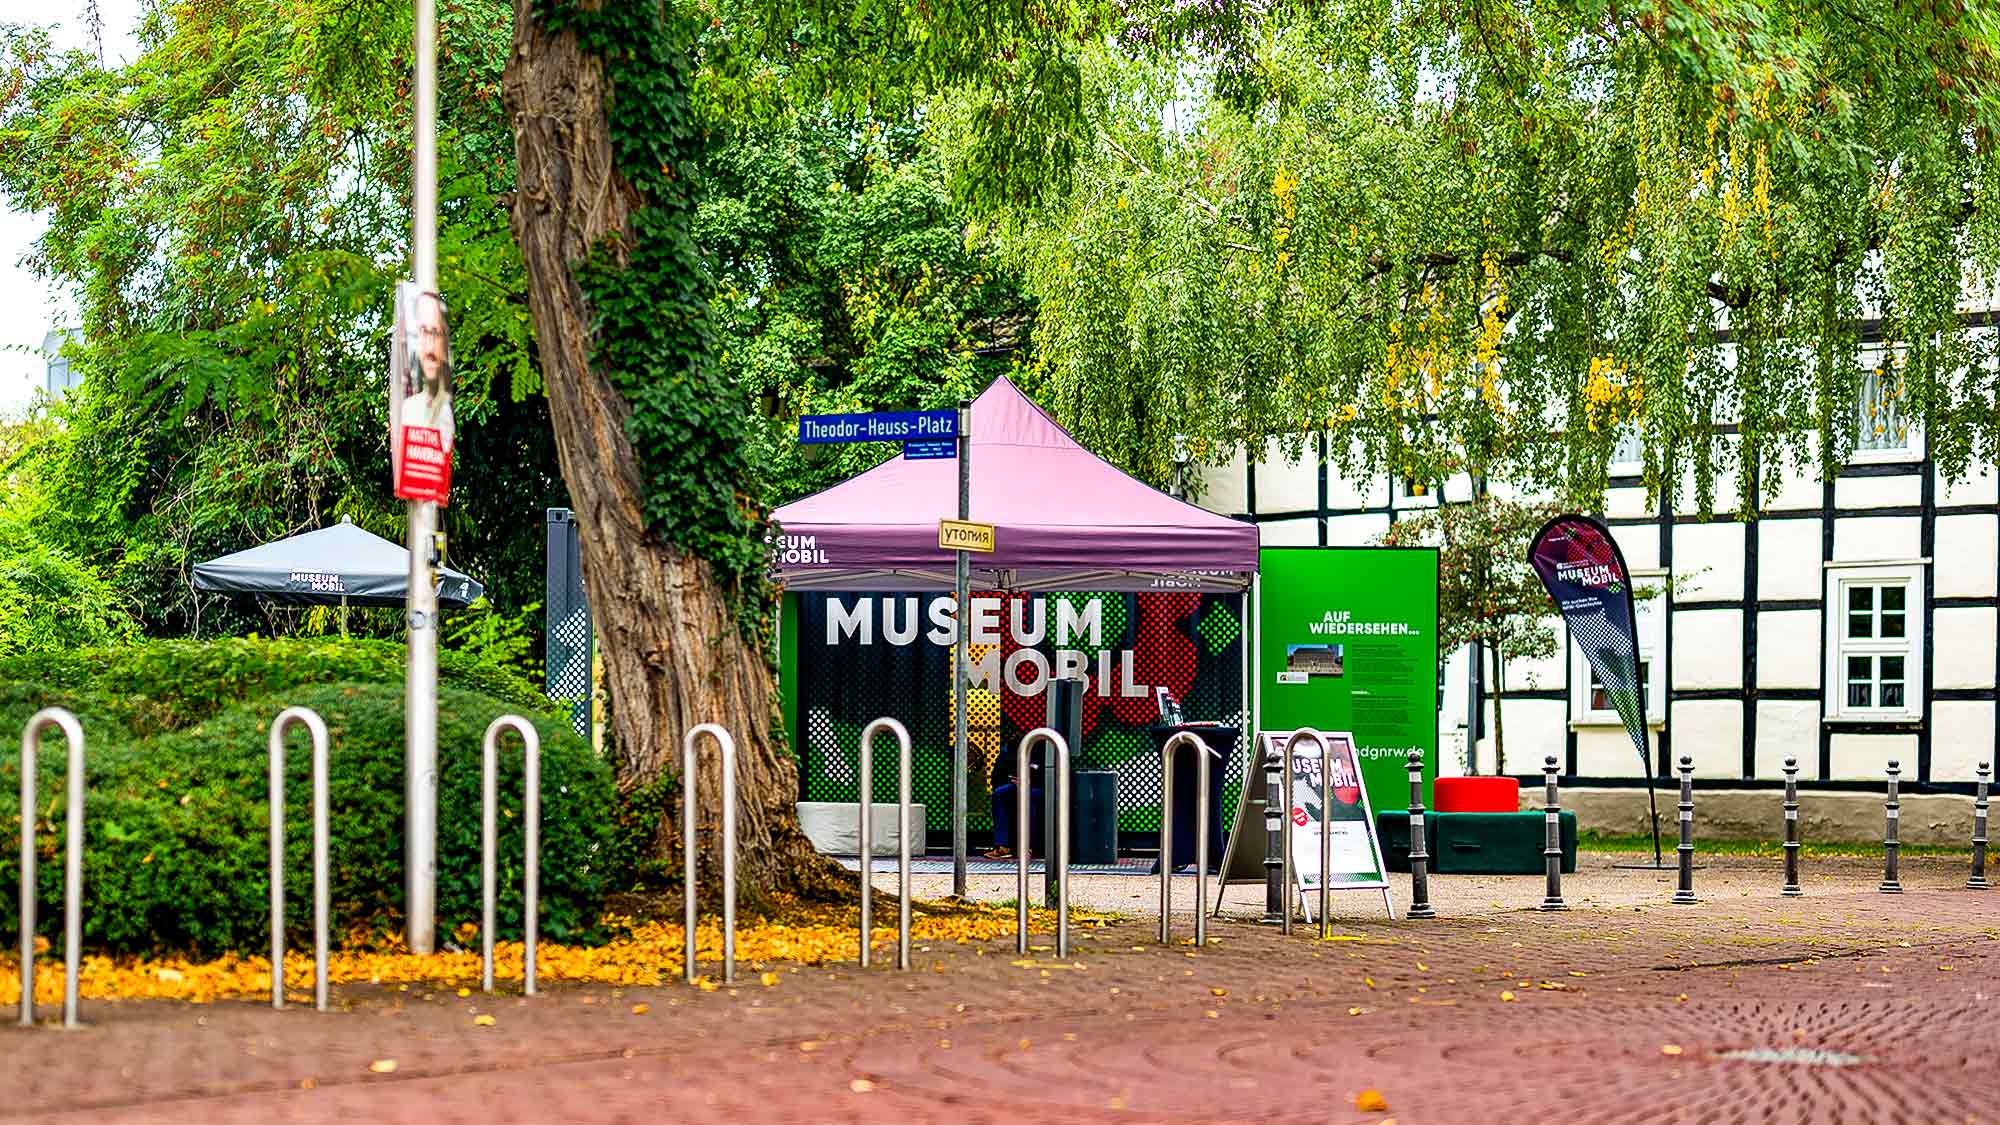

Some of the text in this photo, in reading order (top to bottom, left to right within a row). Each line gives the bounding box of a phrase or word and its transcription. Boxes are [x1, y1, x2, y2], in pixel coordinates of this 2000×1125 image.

[804, 416, 953, 438] Theodor-Heuss-Platz
[290, 573, 339, 583] MUSEUM
[1558, 565, 1609, 581] MUSEUM
[1582, 572, 1620, 587] MOBIL
[312, 581, 345, 592] MOBIL
[826, 596, 1102, 647] MUSEUM
[1323, 611, 1351, 623] AUF
[1309, 623, 1420, 635] WIEDERSEHEN...
[954, 649, 1149, 697] MOBIL
[1309, 772, 1358, 787] MBIL
